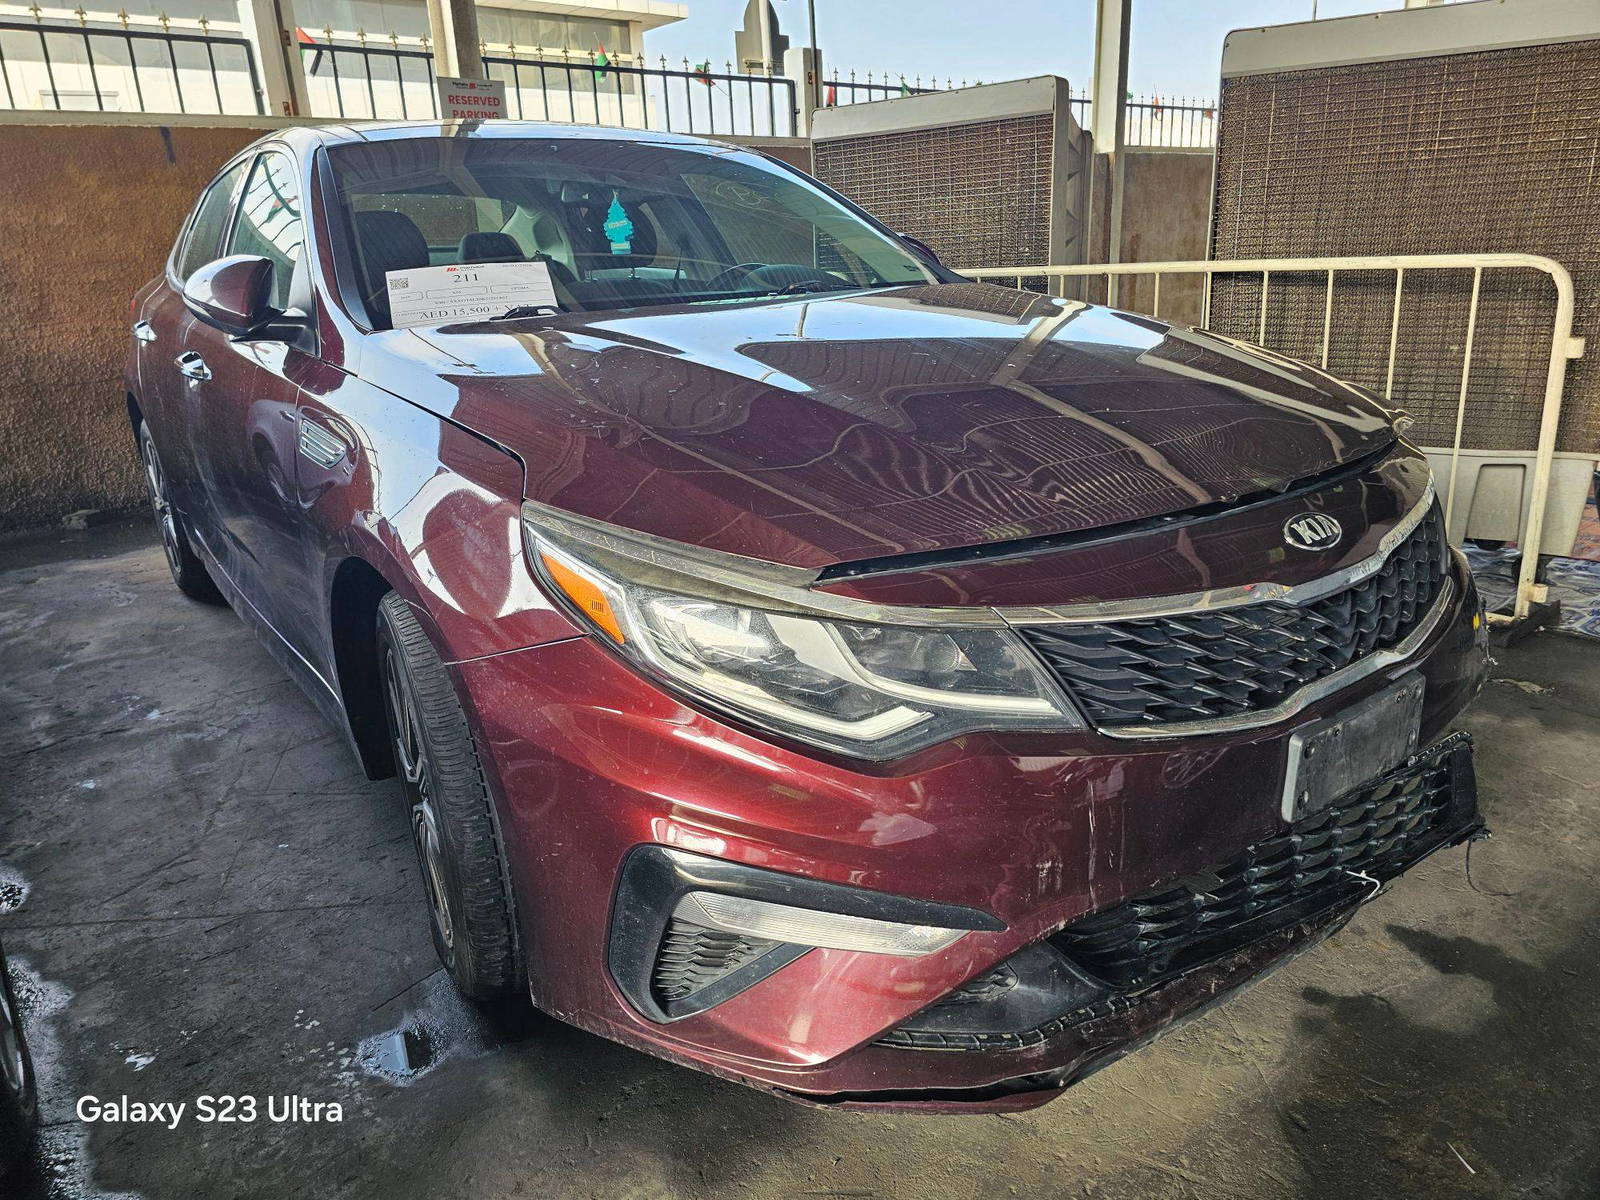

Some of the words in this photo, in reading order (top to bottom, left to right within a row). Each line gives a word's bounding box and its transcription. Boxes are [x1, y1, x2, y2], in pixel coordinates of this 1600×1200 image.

[448, 95, 501, 106] RESERVED
[452, 110, 499, 119] PARKING
[452, 273, 478, 283] 211
[420, 310, 449, 319] AED
[453, 305, 490, 317] 15,500
[1290, 515, 1340, 545] KIA
